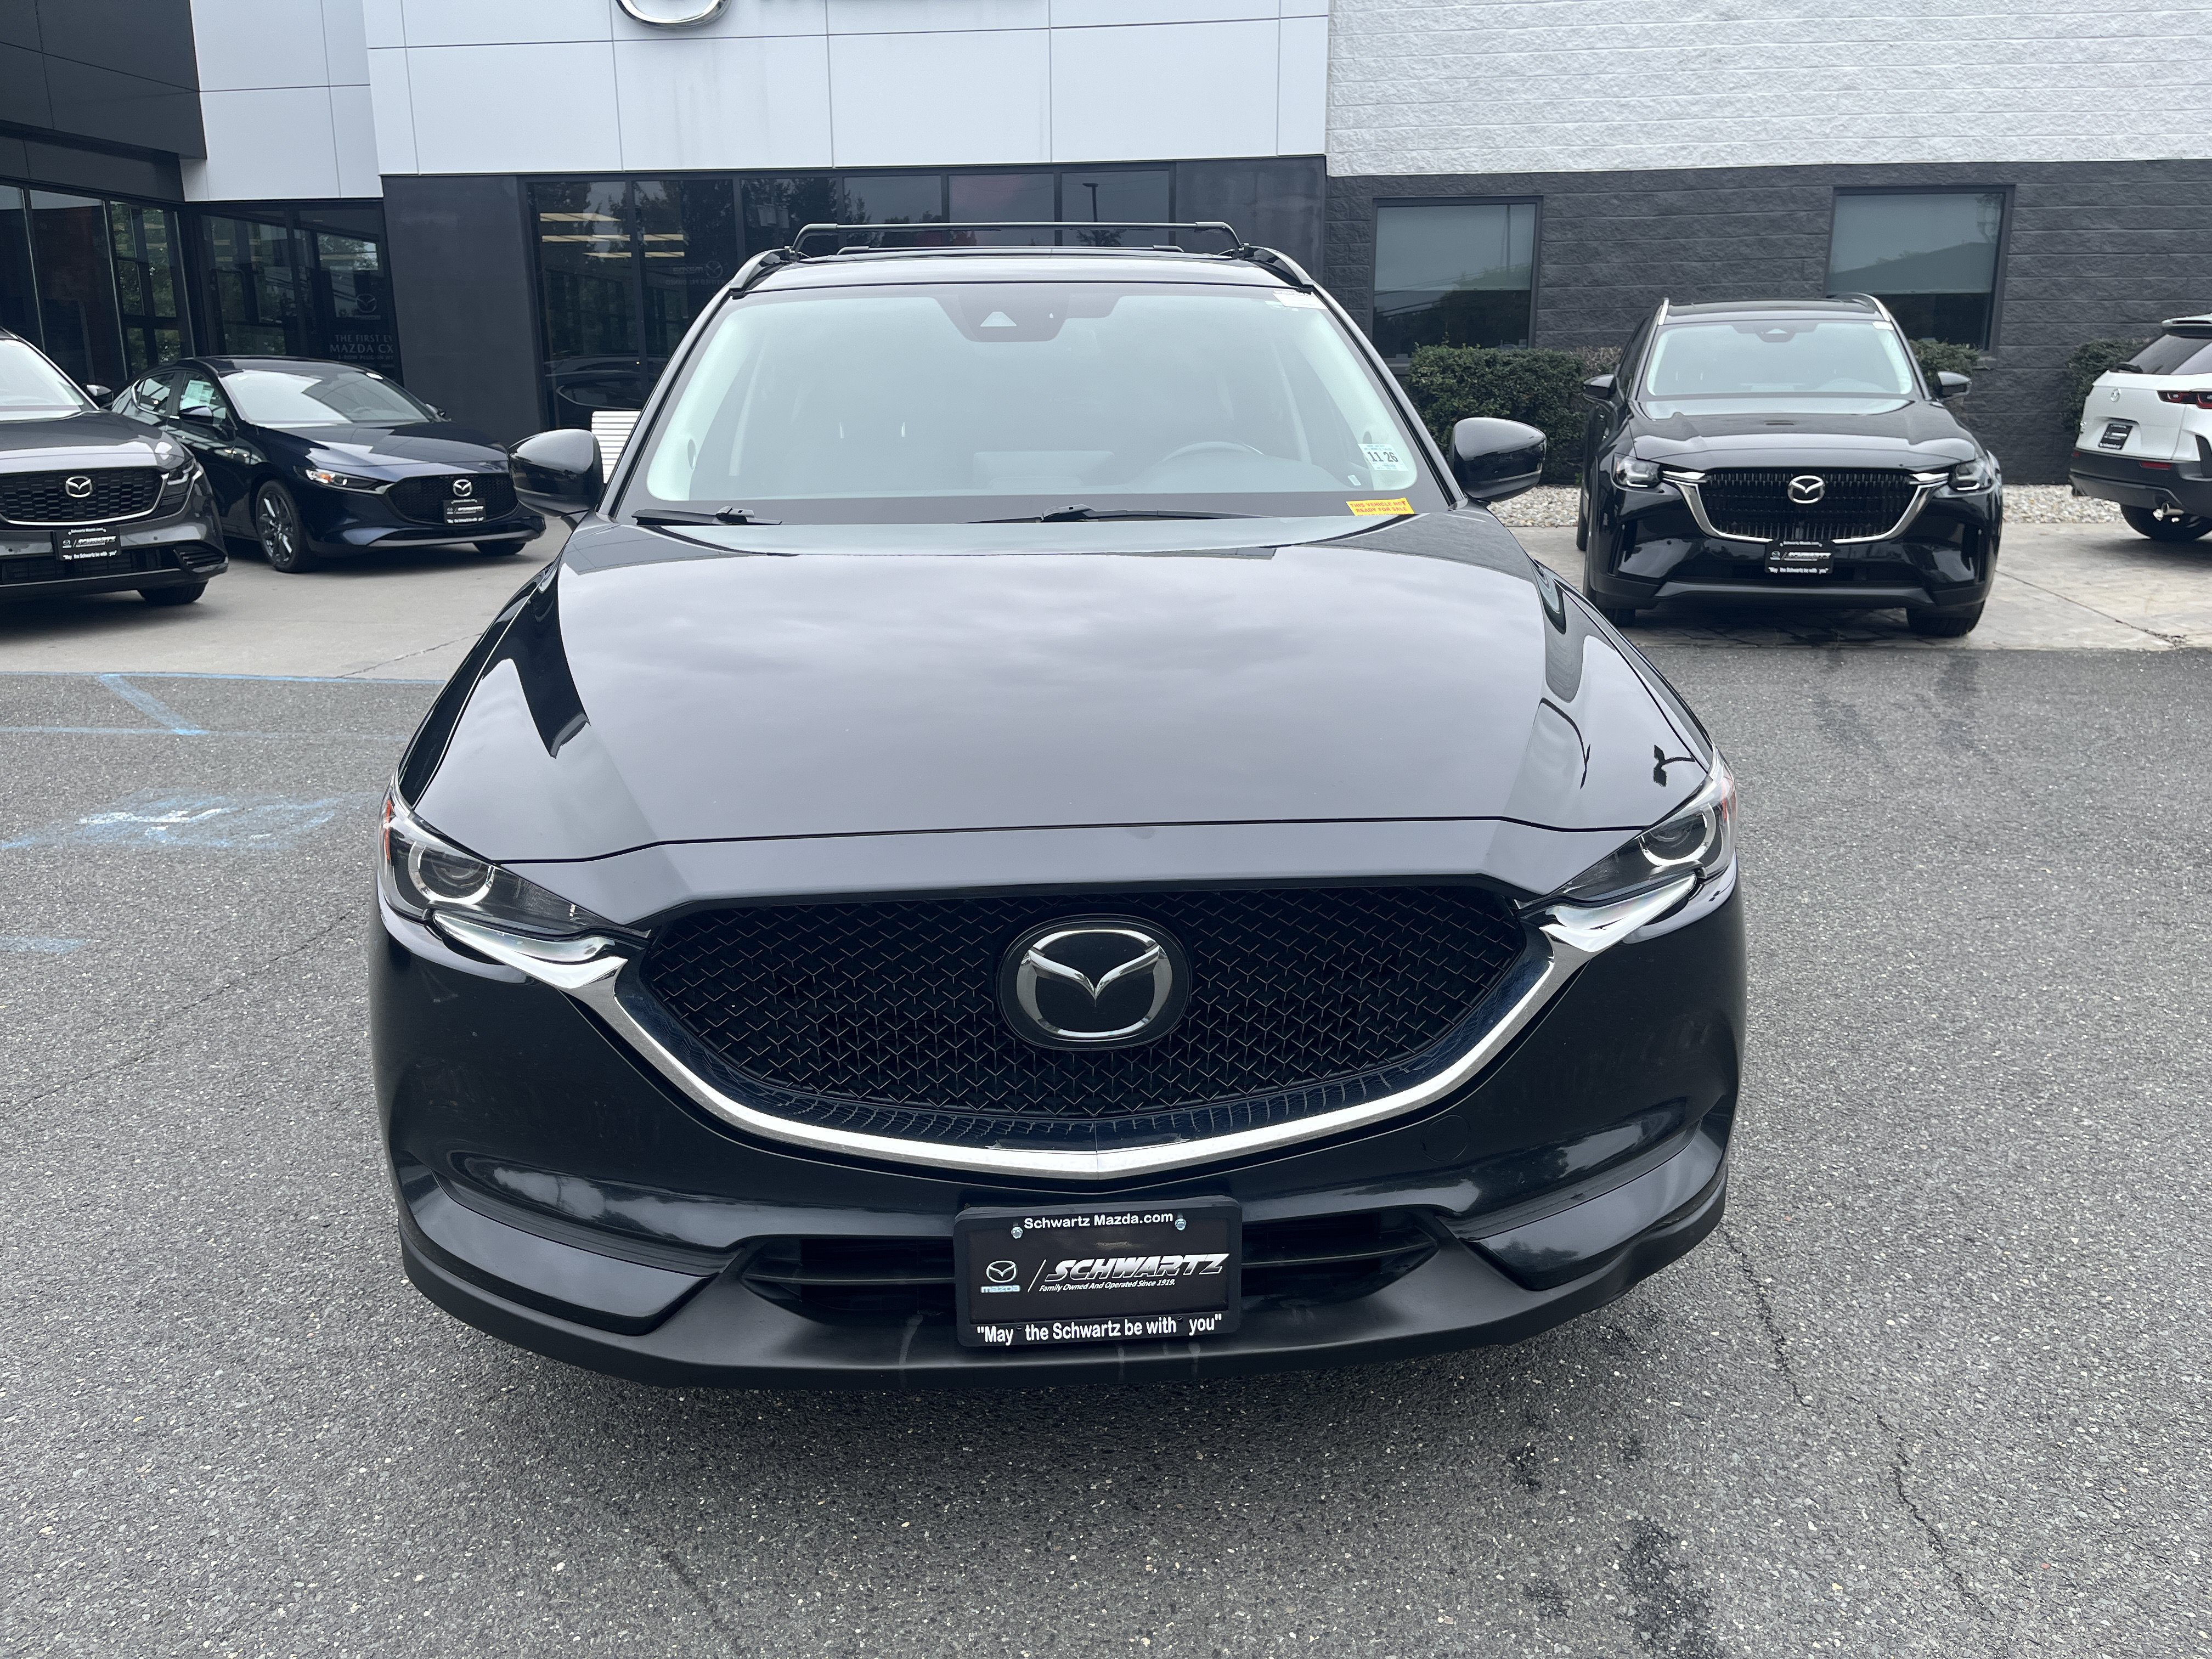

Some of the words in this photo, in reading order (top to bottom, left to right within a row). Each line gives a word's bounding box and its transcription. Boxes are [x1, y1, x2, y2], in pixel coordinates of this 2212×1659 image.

[335, 334, 352, 342] THE
[356, 334, 380, 342] FIRST
[330, 344, 374, 353] MAZDA
[378, 344, 394, 353] CX
[1367, 452, 1384, 462] 11
[1383, 452, 1398, 462] 26
[1024, 1217, 1091, 1229] Schwartz
[1093, 1212, 1174, 1227] Mazda.com
[1045, 1253, 1230, 1282] SCHWARTZ
[1039, 1284, 1062, 1293] Family
[1063, 1283, 1088, 1291] Owned
[1104, 1280, 1138, 1290] Operated
[1156, 1278, 1176, 1286] 1919.
[977, 1326, 1014, 1346] "May
[1025, 1324, 1049, 1341] the
[1052, 1320, 1121, 1340] Schwartz
[1124, 1318, 1143, 1336] be
[1146, 1316, 1176, 1335] with
[1188, 1314, 1223, 1336] you"
